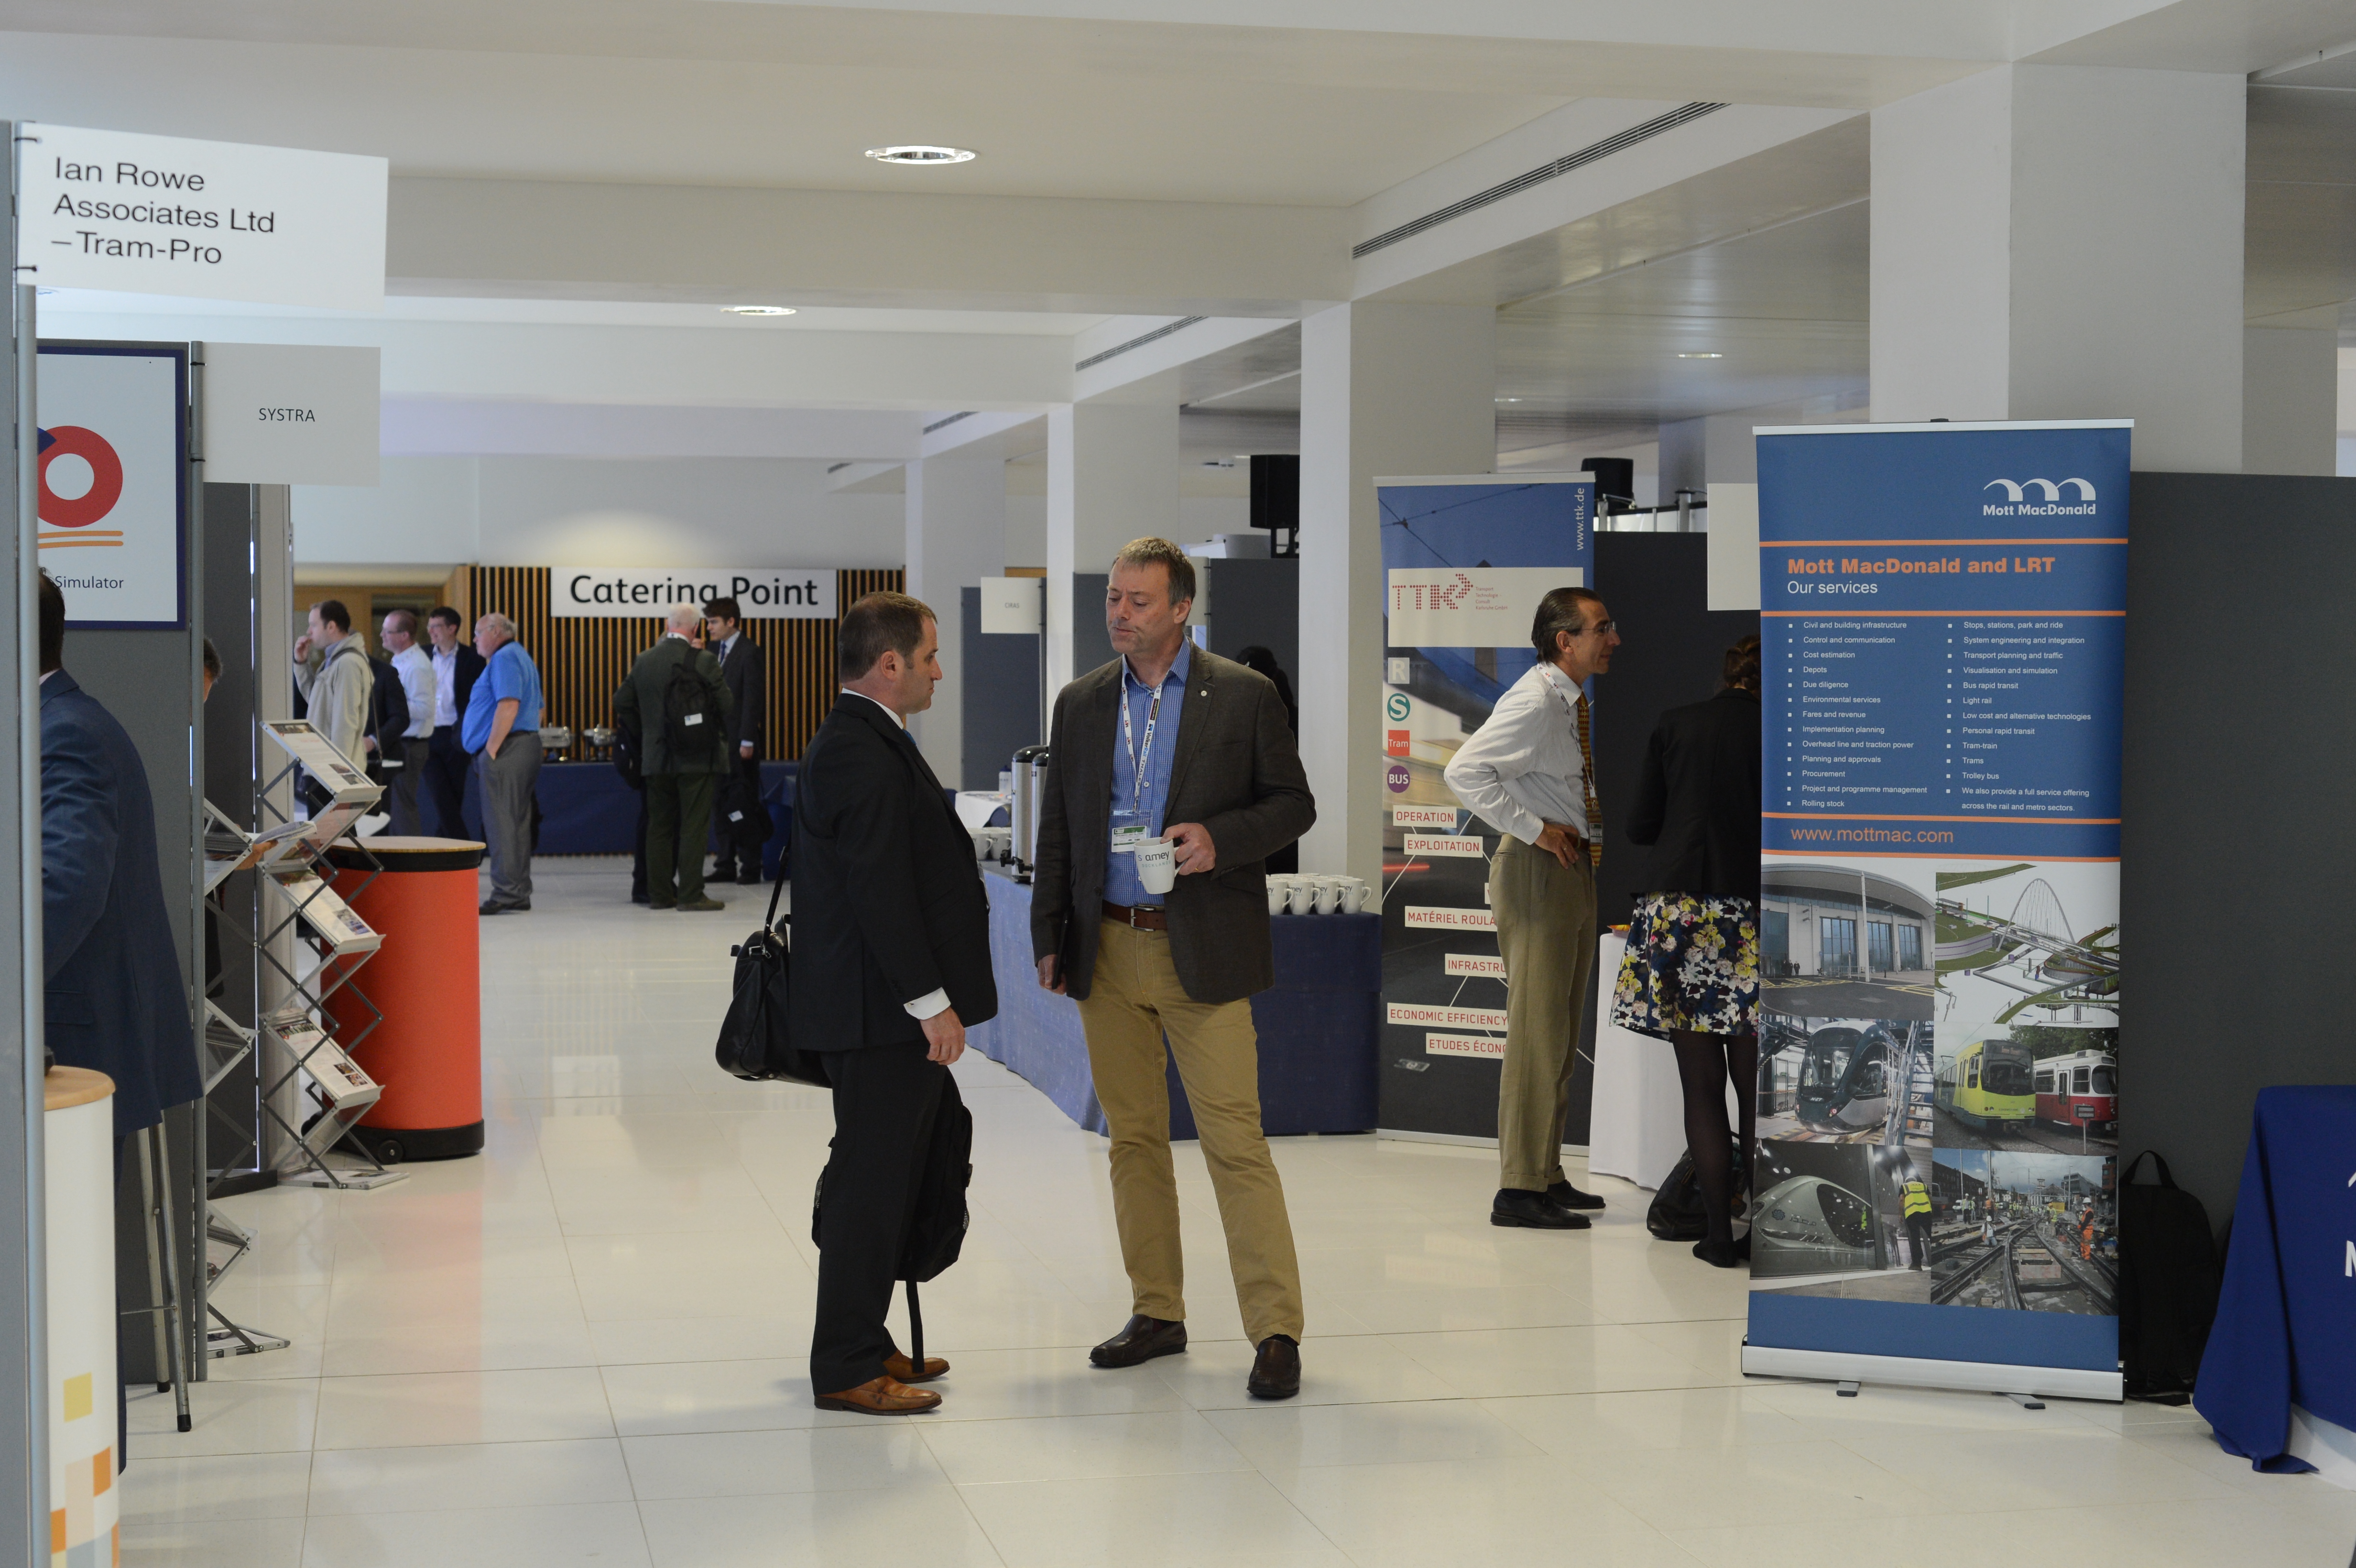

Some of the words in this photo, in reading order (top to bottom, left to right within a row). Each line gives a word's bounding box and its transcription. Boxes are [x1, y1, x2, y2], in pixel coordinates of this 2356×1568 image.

[55, 156, 103, 183] Ian
[116, 162, 205, 192] Rowe
[53, 193, 219, 229] Associates
[229, 208, 275, 234] Ltd
[258, 408, 316, 423] SYSTRA
[1983, 504, 2014, 516] Mott
[2018, 503, 2095, 516] MacDonald
[1573, 487, 1585, 551] www.ttk.de
[1788, 558, 1834, 574] Mott
[1841, 557, 1960, 574] MacDonald
[1966, 557, 2007, 574] and
[2014, 557, 2055, 573] LRT
[55, 576, 124, 589] Simulator
[1787, 580, 1814, 594] Our
[1818, 580, 1877, 594] services
[569, 574, 718, 604] Catering
[732, 576, 818, 606] Point
[1392, 584, 1460, 610] TTK
[1834, 621, 1861, 630] building
[1963, 621, 1985, 630] Stops,
[2017, 621, 2033, 630] park
[1963, 636, 1989, 645] System
[1990, 637, 2031, 645] engineering
[2048, 636, 2084, 645] integration
[1963, 651, 1996, 660] Transport
[1997, 651, 2027, 660] planning
[1392, 660, 1406, 681] R
[1803, 665, 1827, 675] Depots
[1818, 681, 1849, 689] diligence
[1978, 682, 1995, 690] rapid
[1962, 697, 1980, 705] Light
[1390, 696, 1407, 719] S
[2046, 712, 2092, 721] technologies
[1802, 726, 1854, 734] Implementation
[1855, 726, 1885, 734] planning
[1994, 727, 2011, 736] rapid
[1143, 732, 1152, 757] VolkerRail
[1388, 739, 1408, 748] Tram
[1802, 755, 1832, 764] Planning
[1847, 756, 1881, 764] approvals
[1137, 760, 1145, 786] THALES
[1389, 774, 1408, 784] BUS
[1961, 772, 1985, 781] Trolley
[1801, 784, 1825, 793] Project
[1991, 787, 2016, 796] provide
[2062, 789, 2090, 798] offering
[1801, 799, 1825, 808] Rolling
[1396, 810, 1454, 823] OPERATION
[1791, 827, 1953, 843] www.mottmac.com
[1407, 838, 1480, 852] EXPLOITATION
[1145, 850, 1169, 861] amey
[1407, 910, 1459, 925] MATÉRIEL
[1390, 1008, 1443, 1022] ECONOMIC
[1448, 1013, 1507, 1026] EFFICIENCY
[1429, 1039, 1470, 1051] ETUDES
